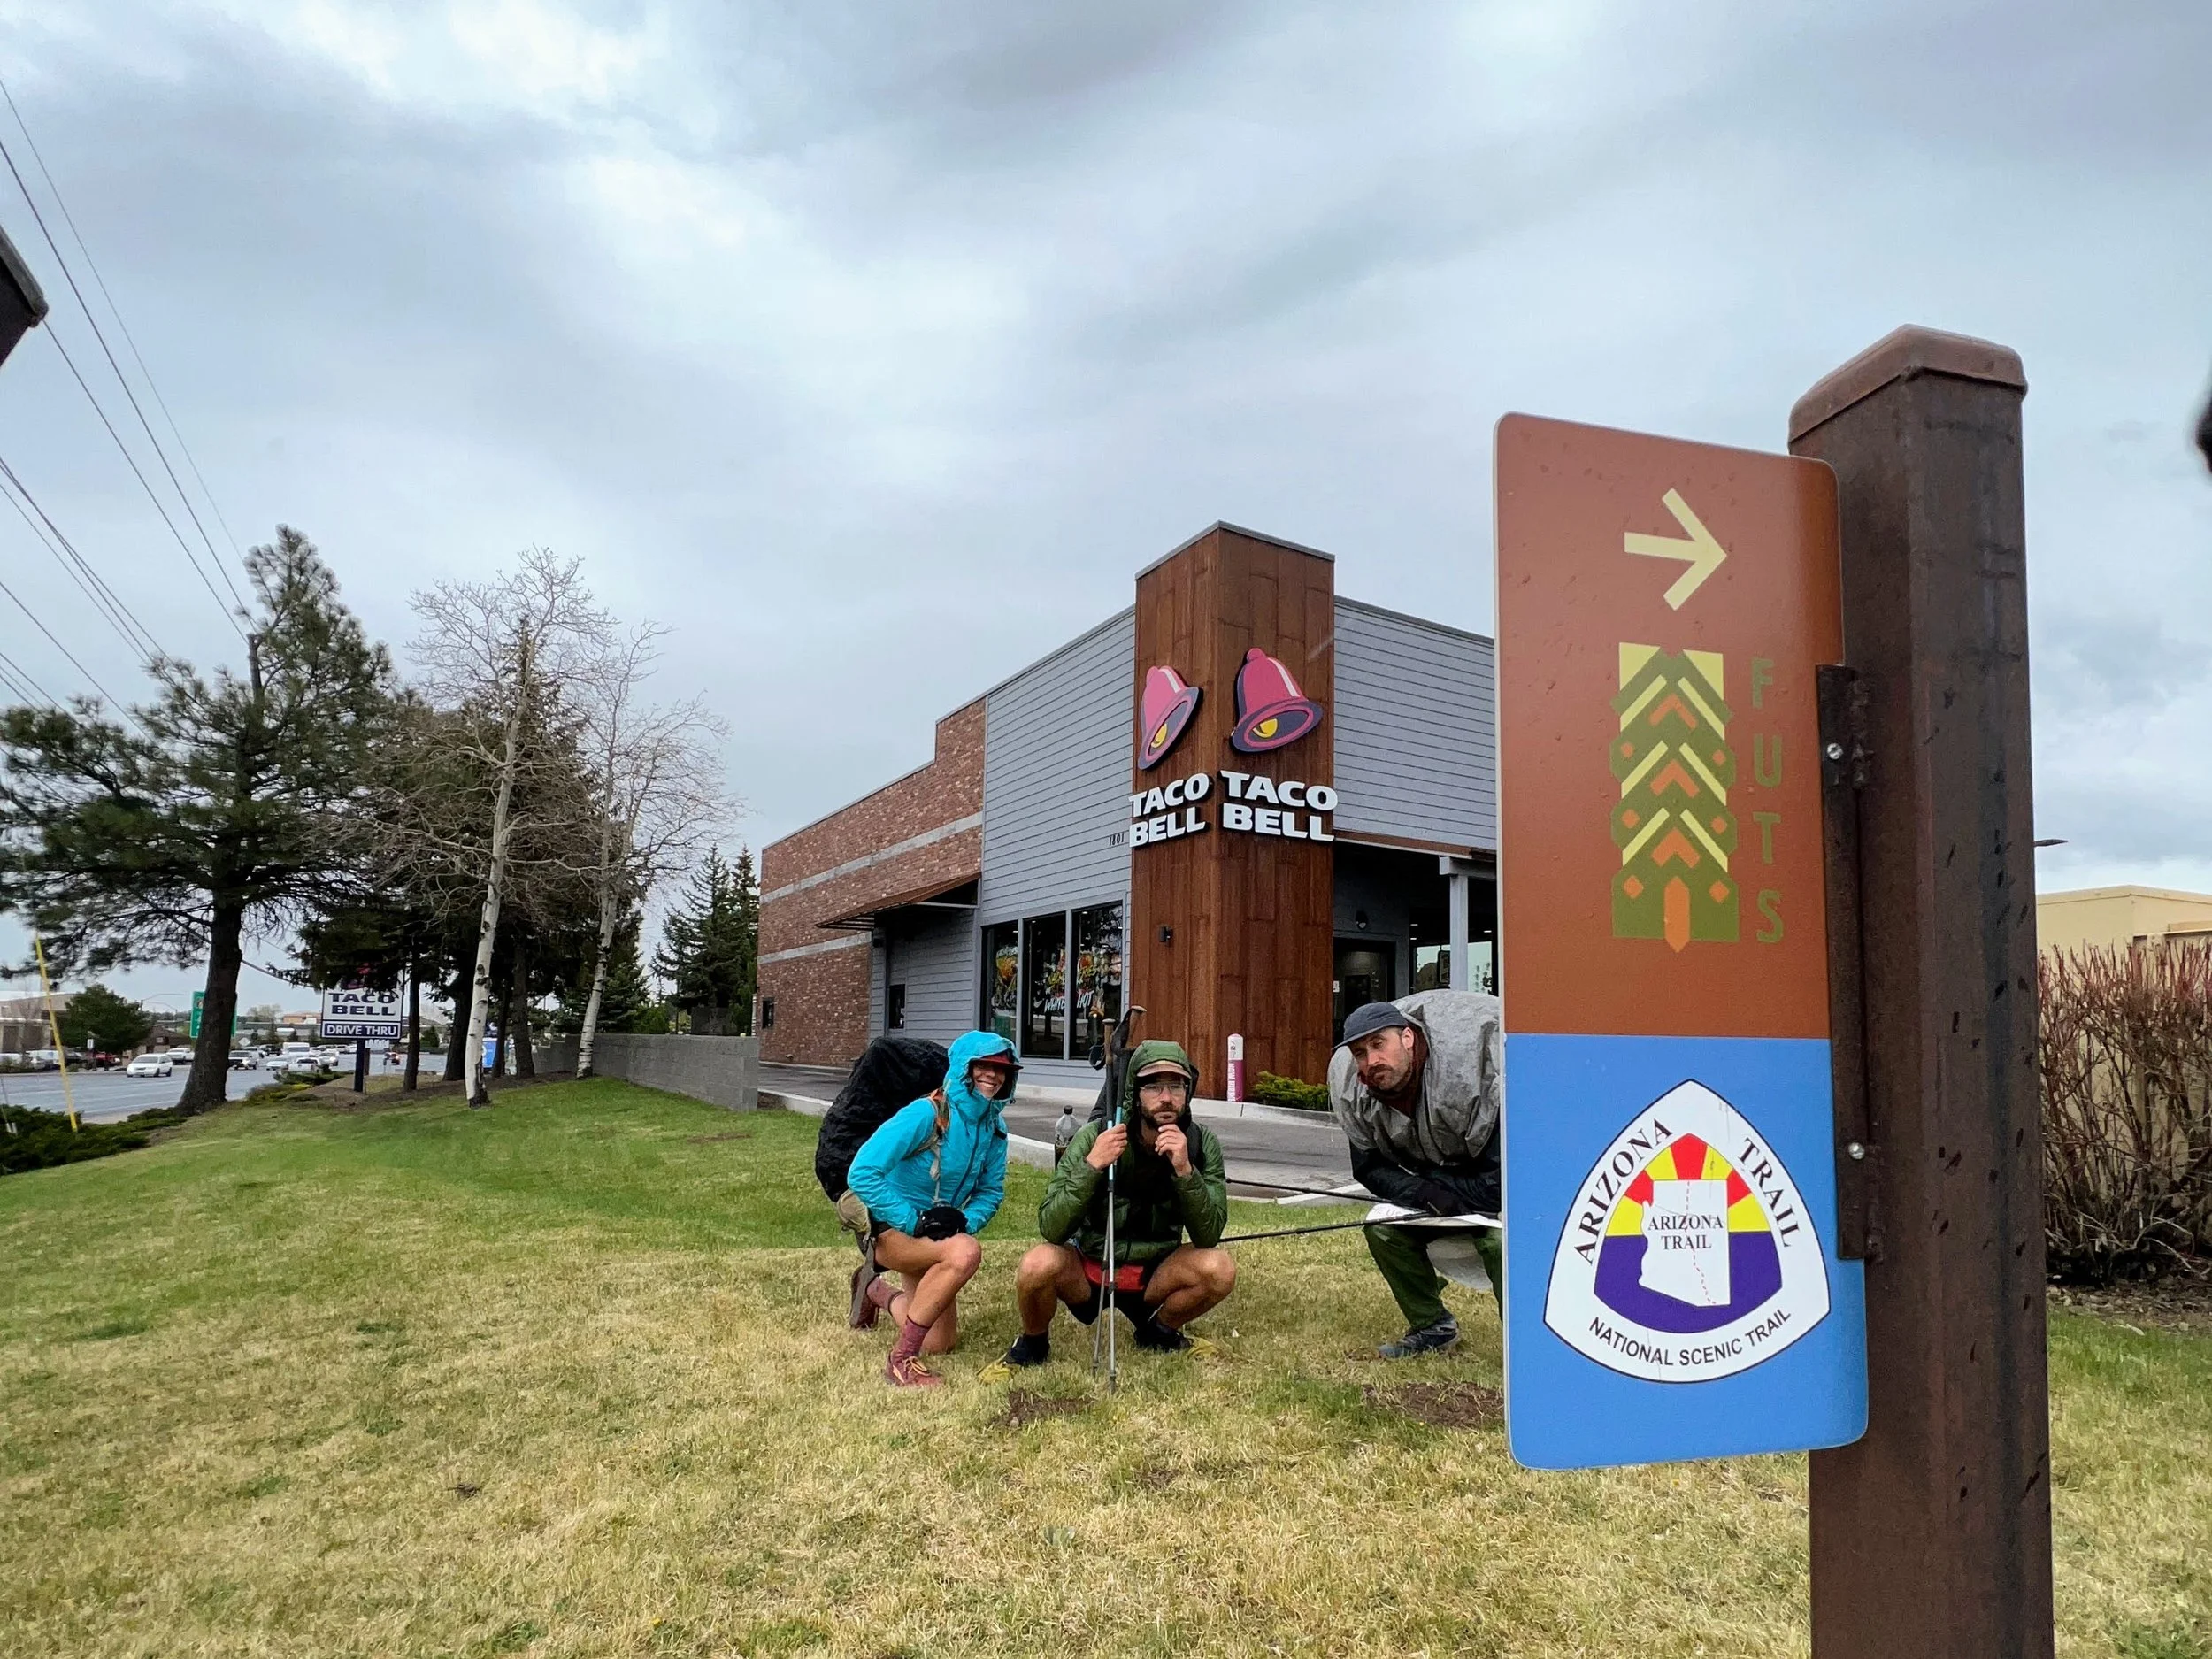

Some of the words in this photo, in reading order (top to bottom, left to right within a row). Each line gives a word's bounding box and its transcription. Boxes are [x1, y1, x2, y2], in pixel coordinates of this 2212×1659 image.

[1128, 772, 1210, 818] TACO
[1220, 770, 1339, 811] TACO
[1751, 657, 1784, 943] FUTS
[1109, 833, 1125, 847] 1801
[1129, 806, 1206, 848] BELL
[1223, 803, 1334, 842] BELL
[328, 992, 396, 1003] TACO
[331, 1005, 396, 1016] BELL
[326, 1025, 362, 1035] DRIVE
[365, 1025, 396, 1035] THRU
[1574, 1118, 1673, 1265] ARIZONA
[1738, 1137, 1801, 1248] TRAIL
[1647, 1214, 1724, 1231] ARIZONA
[1660, 1233, 1713, 1250] TRAIL
[1588, 1316, 1674, 1366] NATIONAL
[1678, 1337, 1744, 1366] SCENIC
[1744, 1308, 1792, 1347] TRAIL
